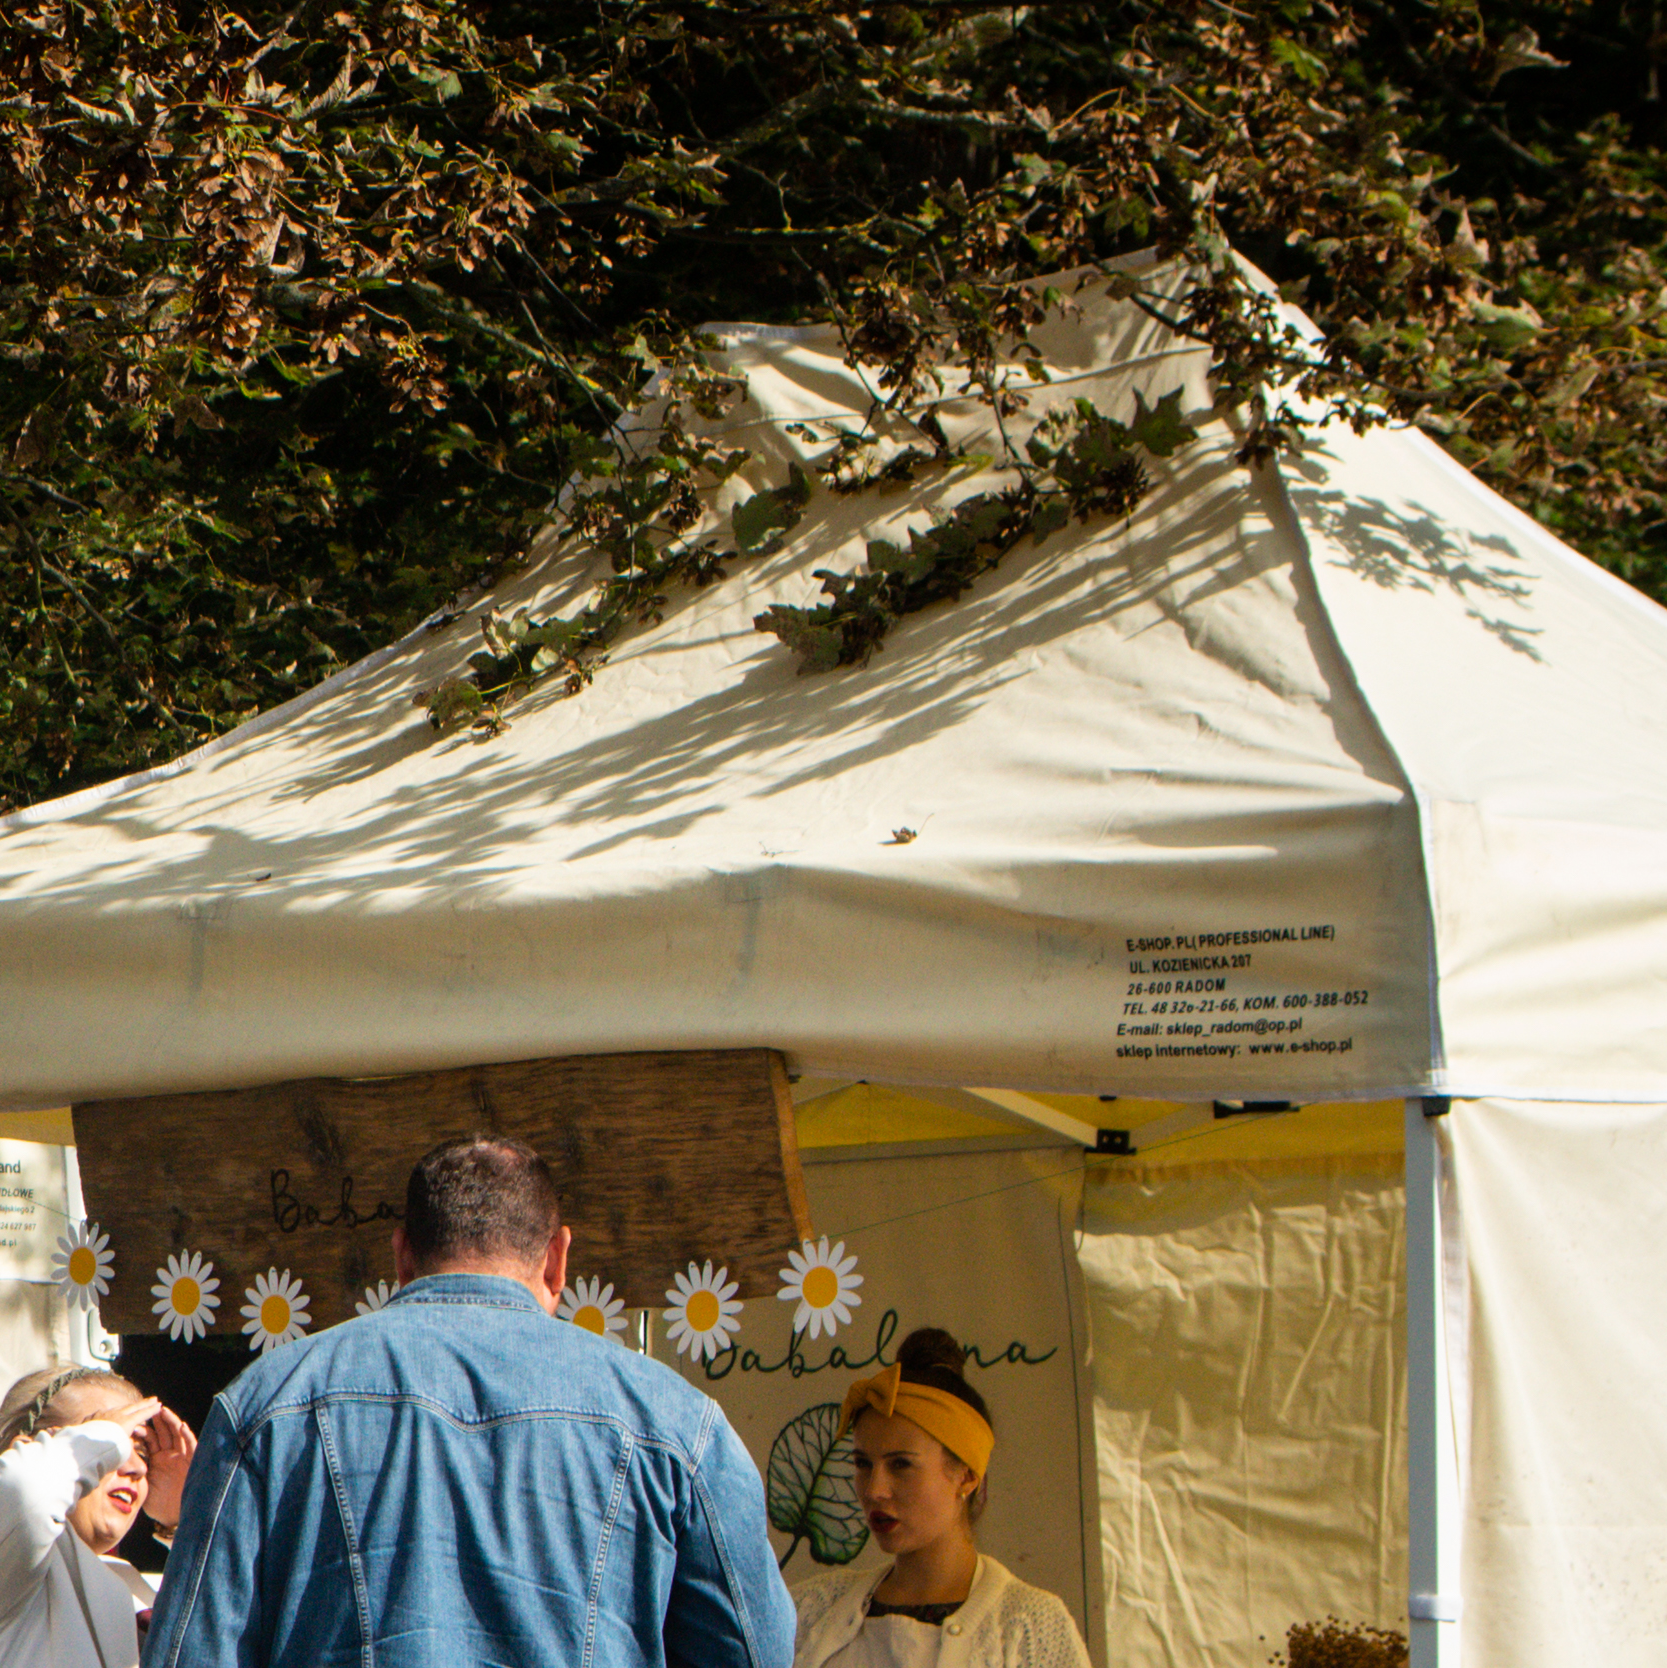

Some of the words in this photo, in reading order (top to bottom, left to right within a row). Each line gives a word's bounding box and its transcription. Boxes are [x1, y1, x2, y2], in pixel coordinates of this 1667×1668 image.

[1198, 927, 1299, 947] PROFESSIONAL
[1301, 924, 1335, 941] LINE)
[1129, 960, 1150, 974] UL.
[1152, 956, 1229, 973] KOZIENICKA
[1231, 954, 1251, 968] 207
[1127, 981, 1172, 995] 26-600
[1174, 977, 1226, 993] RADOM
[1123, 1002, 1148, 1015] TEL.
[1151, 1001, 1168, 1014] 48
[1243, 996, 1279, 1011] KOM.
[1282, 990, 1369, 1009] 600-388-052
[1116, 1021, 1163, 1036] E-mail:
[1166, 1017, 1303, 1037] sklep_radom@op.pl
[1116, 1044, 1153, 1060] sklep
[1155, 1043, 1241, 1059] internetowy:
[1249, 1036, 1353, 1055] www.e-shop.pl
